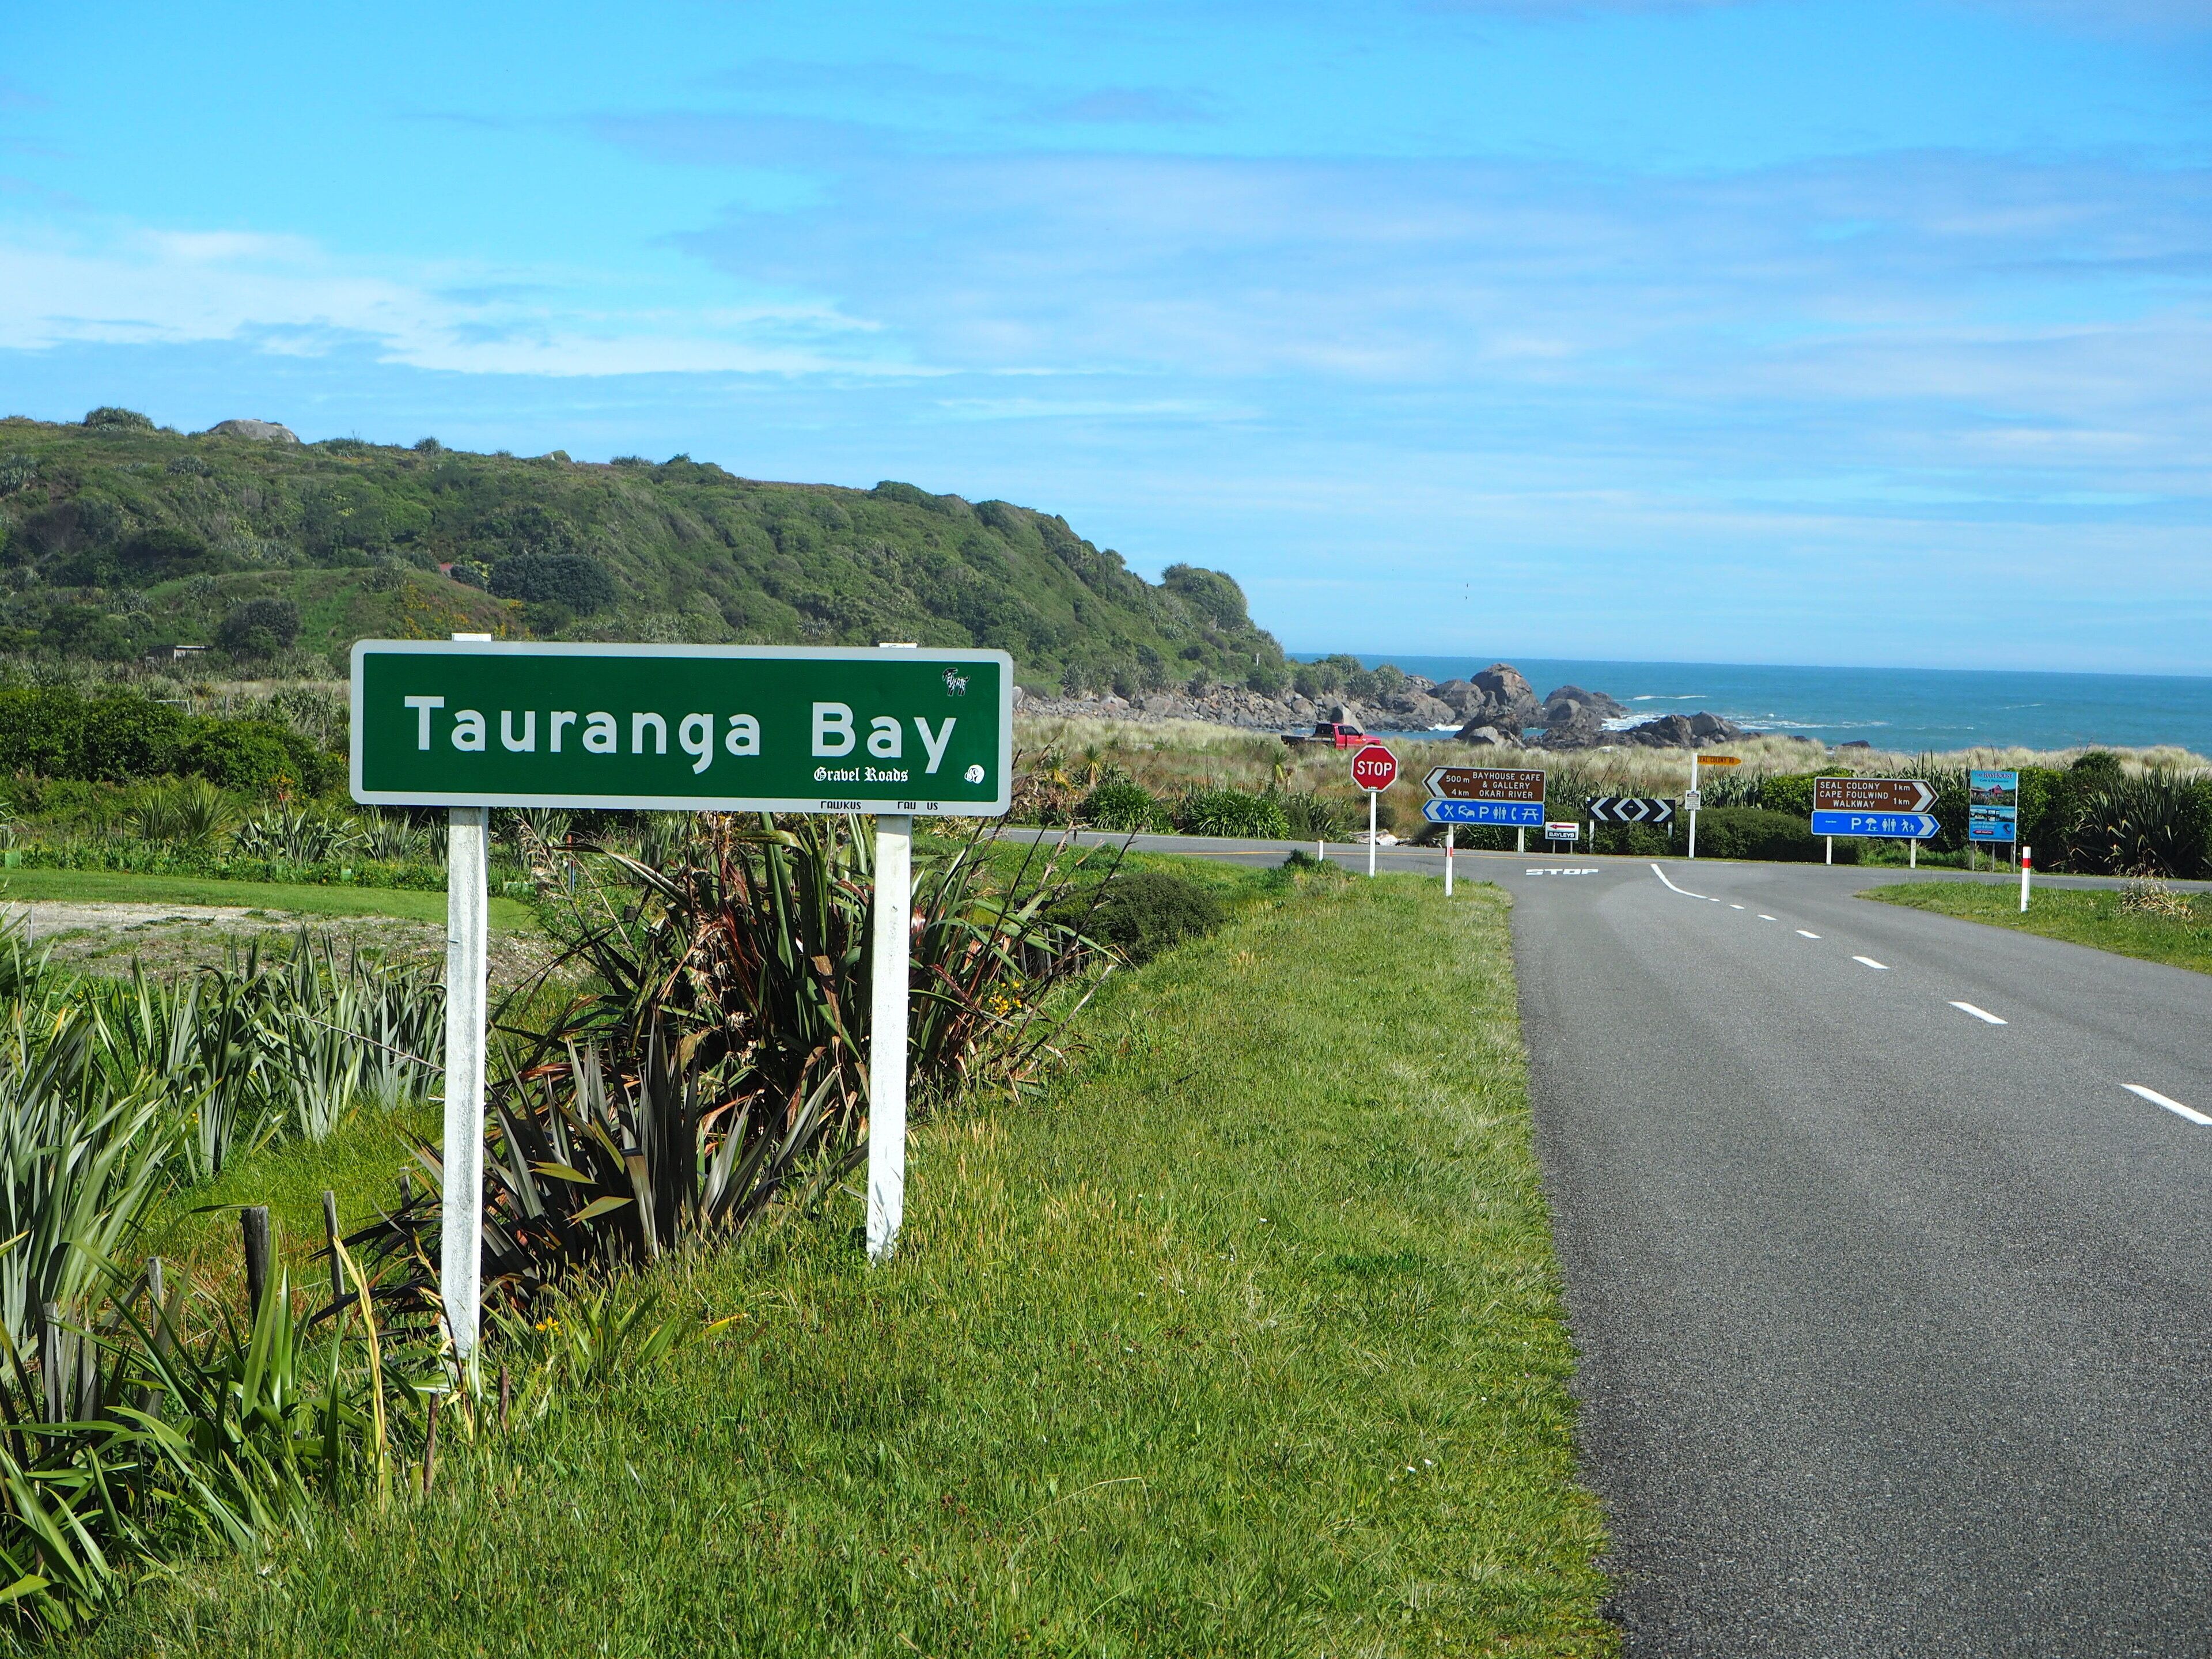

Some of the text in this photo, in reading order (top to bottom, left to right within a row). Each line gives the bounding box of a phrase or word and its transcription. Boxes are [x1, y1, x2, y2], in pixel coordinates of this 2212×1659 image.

[405, 696, 957, 774] Tauranga Bay
[814, 767, 908, 782] Gravel Roads
[1357, 760, 1392, 777] STOP
[1473, 772, 1515, 781] BAYHOUSE
[1479, 790, 1504, 798] OKARI
[1833, 800, 1875, 808] WALKWAY
